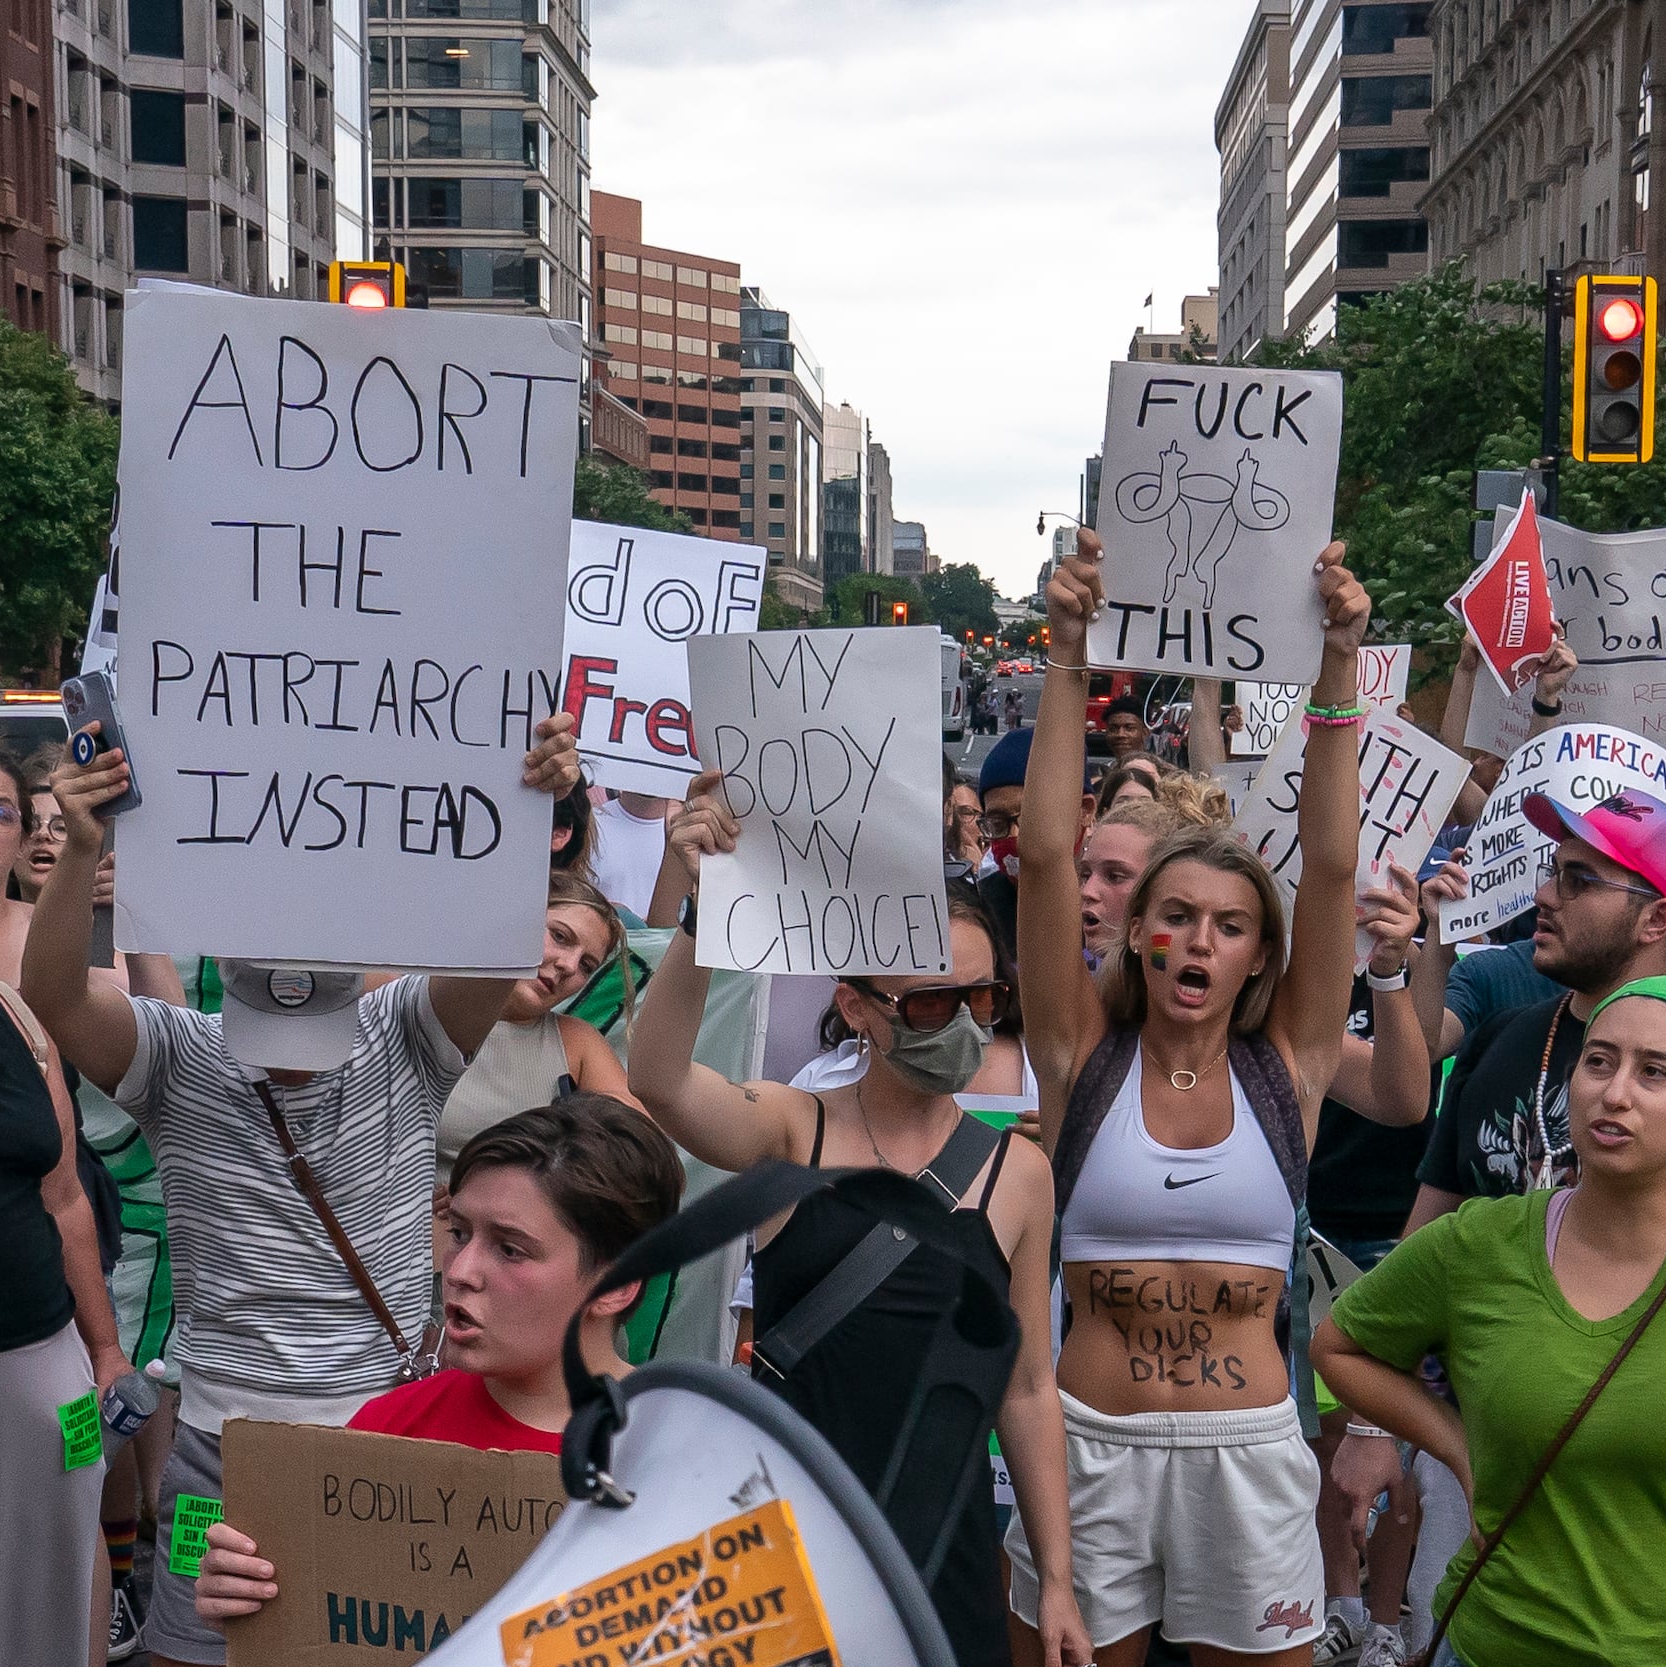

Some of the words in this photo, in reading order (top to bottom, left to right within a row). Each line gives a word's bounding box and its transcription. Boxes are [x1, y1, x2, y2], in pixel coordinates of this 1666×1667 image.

[168, 333, 578, 478] ABORT
[1136, 378, 1313, 445] FUCK
[211, 520, 402, 616] THE
[1514, 561, 1530, 597] LIVE
[1545, 558, 1630, 605] ans
[1108, 600, 1265, 671] THIS
[1508, 599, 1527, 646] ACTION
[152, 640, 562, 750] PATRIARCHY
[748, 634, 855, 718] MY
[563, 654, 700, 762] Fre
[715, 718, 896, 819] BODY
[176, 769, 503, 861] INSTEAD
[774, 820, 857, 889] MY
[1482, 824, 1526, 860] MORE
[1471, 855, 1528, 898] RIGHTS
[727, 893, 947, 973] CHOICE!
[1449, 910, 1489, 932] more
[1090, 1268, 1270, 1319] REGULATE
[1112, 1319, 1212, 1354] YOUR
[1130, 1354, 1247, 1390] DICKS
[323, 1474, 457, 1526] BODILY
[176, 1543, 206, 1559] DISCU
[183, 1529, 199, 1543] SIN
[410, 1542, 432, 1572] IS
[450, 1546, 473, 1579] A
[713, 1522, 767, 1564] ON
[326, 1592, 471, 1653] HUMA
[574, 1574, 728, 1649] DEMAND
